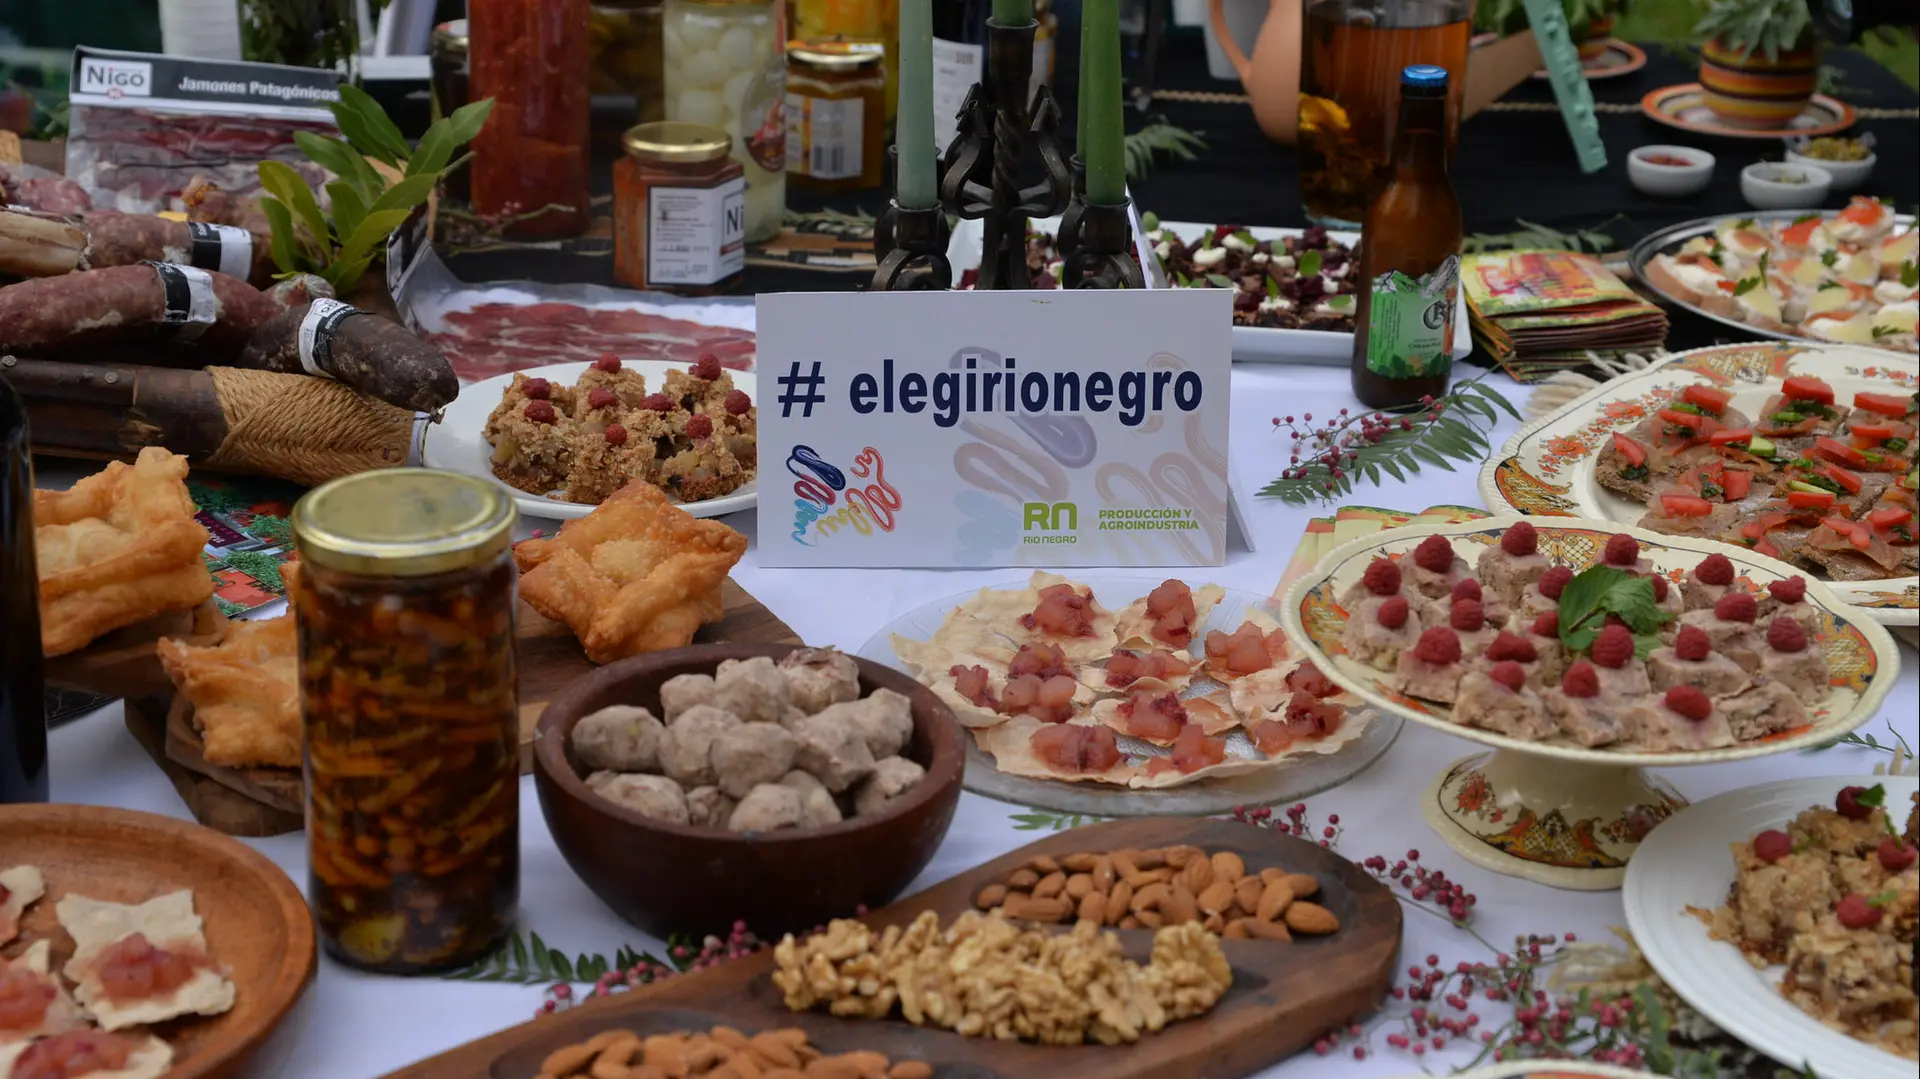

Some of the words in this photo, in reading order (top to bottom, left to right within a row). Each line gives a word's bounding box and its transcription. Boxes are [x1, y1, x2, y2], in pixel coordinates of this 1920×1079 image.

[178, 76, 247, 93] Jamones
[249, 80, 339, 101] Patagónicos
[778, 361, 826, 418] #
[849, 357, 1203, 428] elegirionegro
[1098, 507, 1181, 519] PRODUCCIÓN
[1184, 509, 1193, 519] Y
[1098, 519, 1199, 530] AGROINDUSTRIA
[1041, 535, 1077, 544] NEGRO
